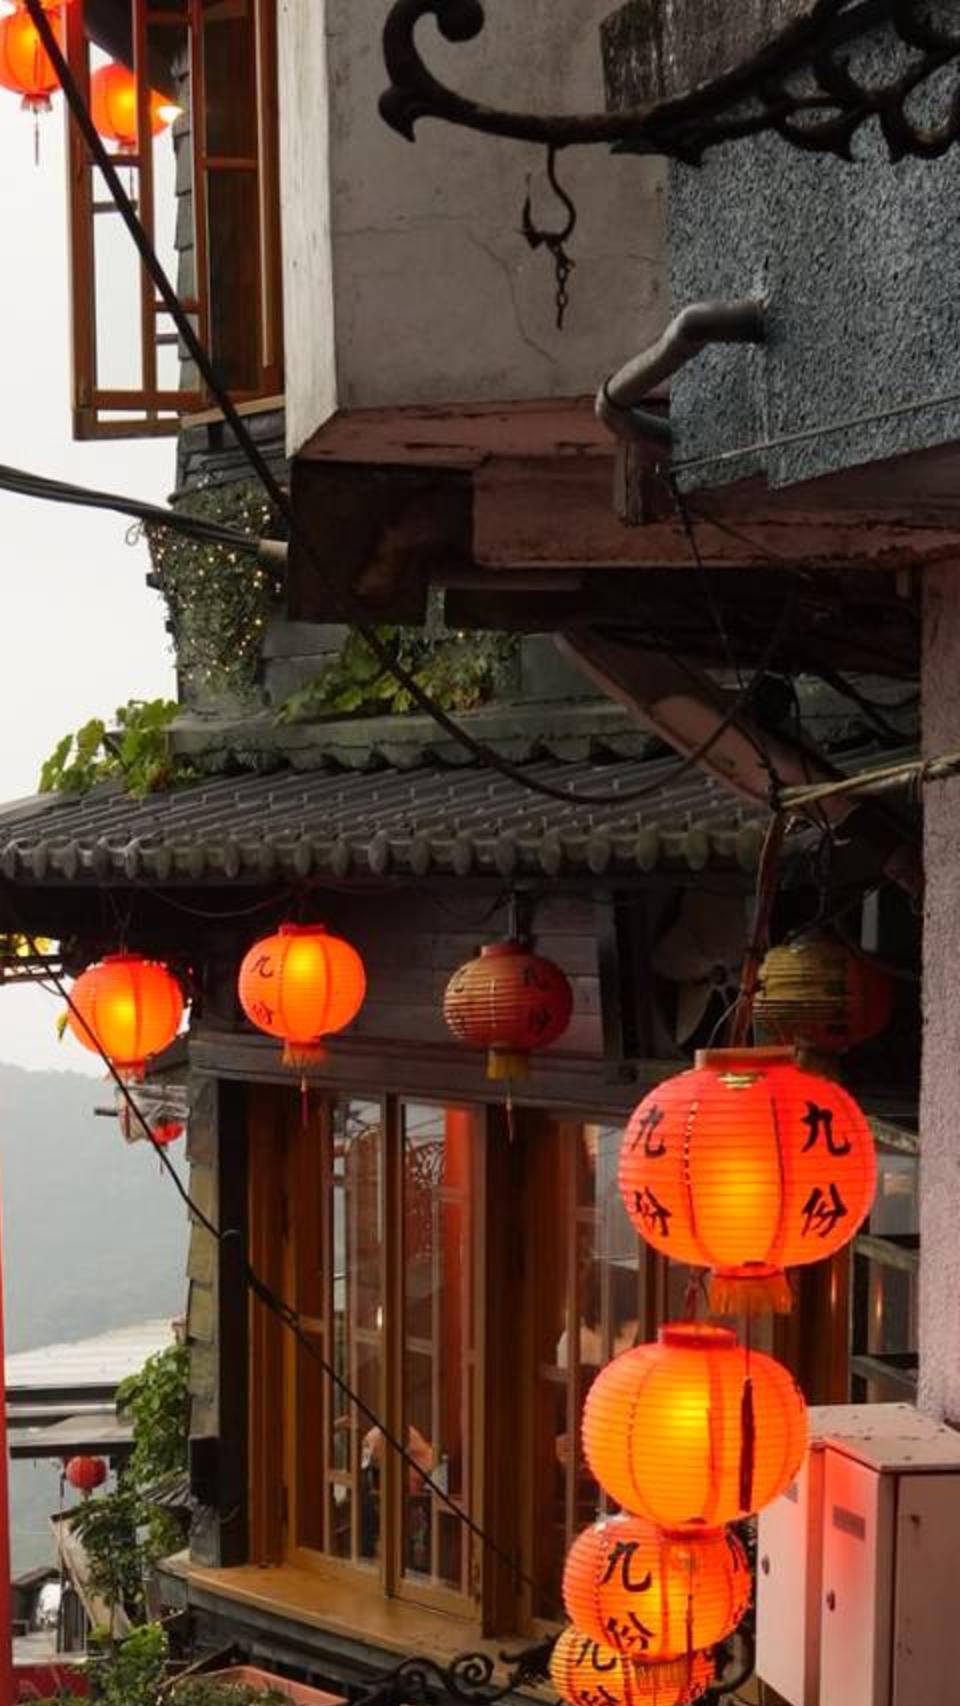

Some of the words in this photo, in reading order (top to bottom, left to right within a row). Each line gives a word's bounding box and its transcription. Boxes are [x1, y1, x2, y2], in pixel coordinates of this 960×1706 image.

[630, 1103, 672, 1237] 九份
[801, 1101, 851, 1238] 九份
[600, 1540, 655, 1652] 九份
